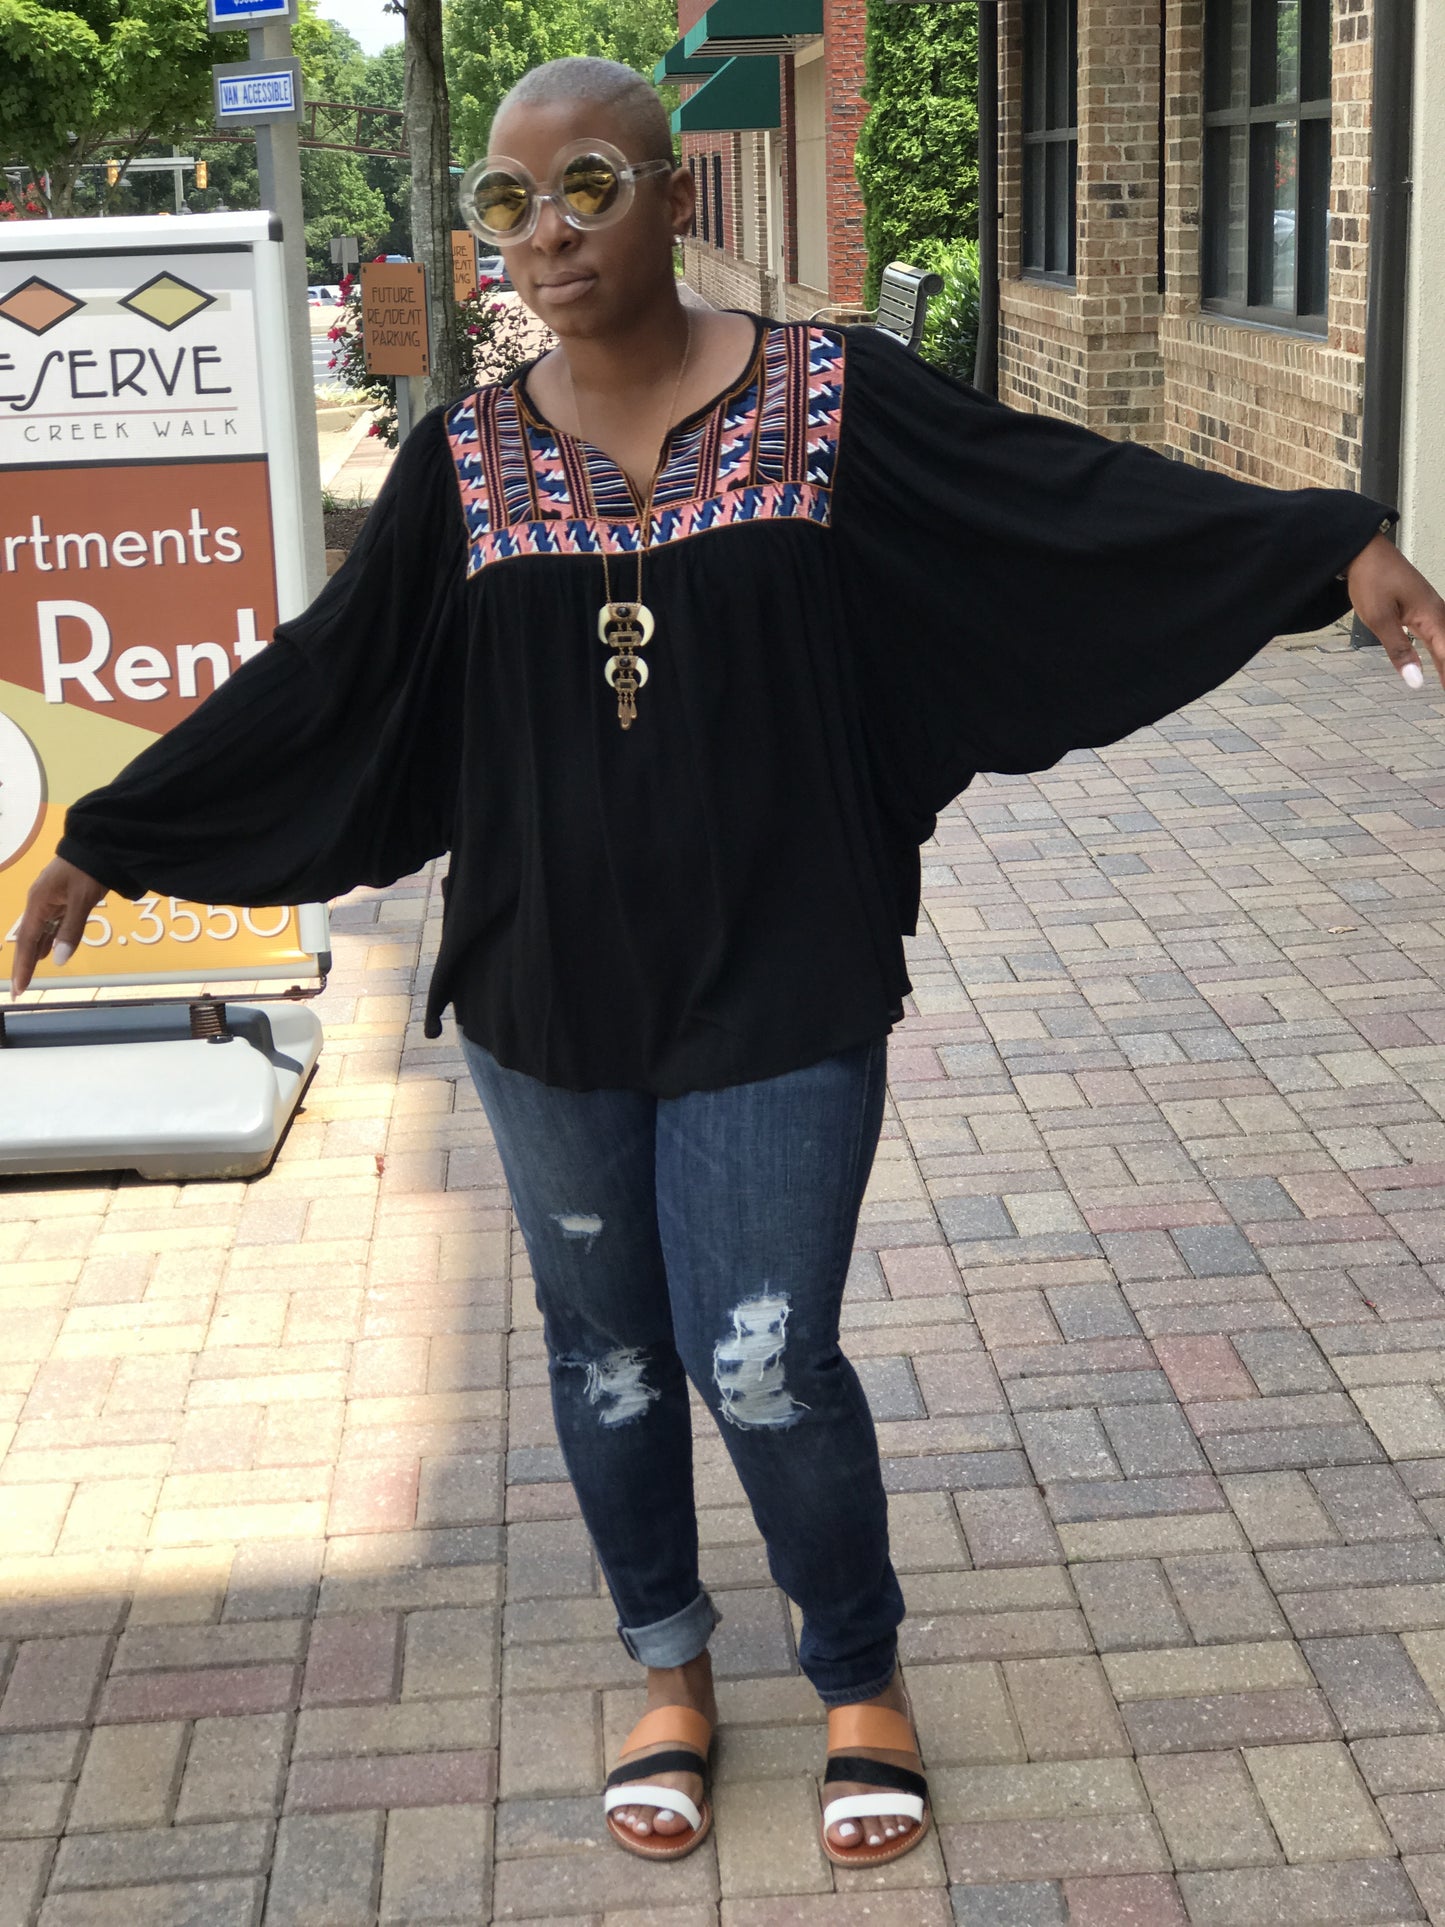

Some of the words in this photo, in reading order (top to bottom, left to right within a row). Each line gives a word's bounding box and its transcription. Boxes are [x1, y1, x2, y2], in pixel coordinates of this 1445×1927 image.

[223, 85, 239, 105] VAN
[243, 80, 289, 104] ACCESSIBLE
[372, 287, 416, 303] FUTURE
[367, 309, 422, 327] RESIDENT
[372, 330, 421, 347] PARKING
[24, 422, 129, 442] CREEK
[153, 418, 238, 438] WALK
[4, 508, 243, 572] rtments
[36, 600, 268, 704] Rent
